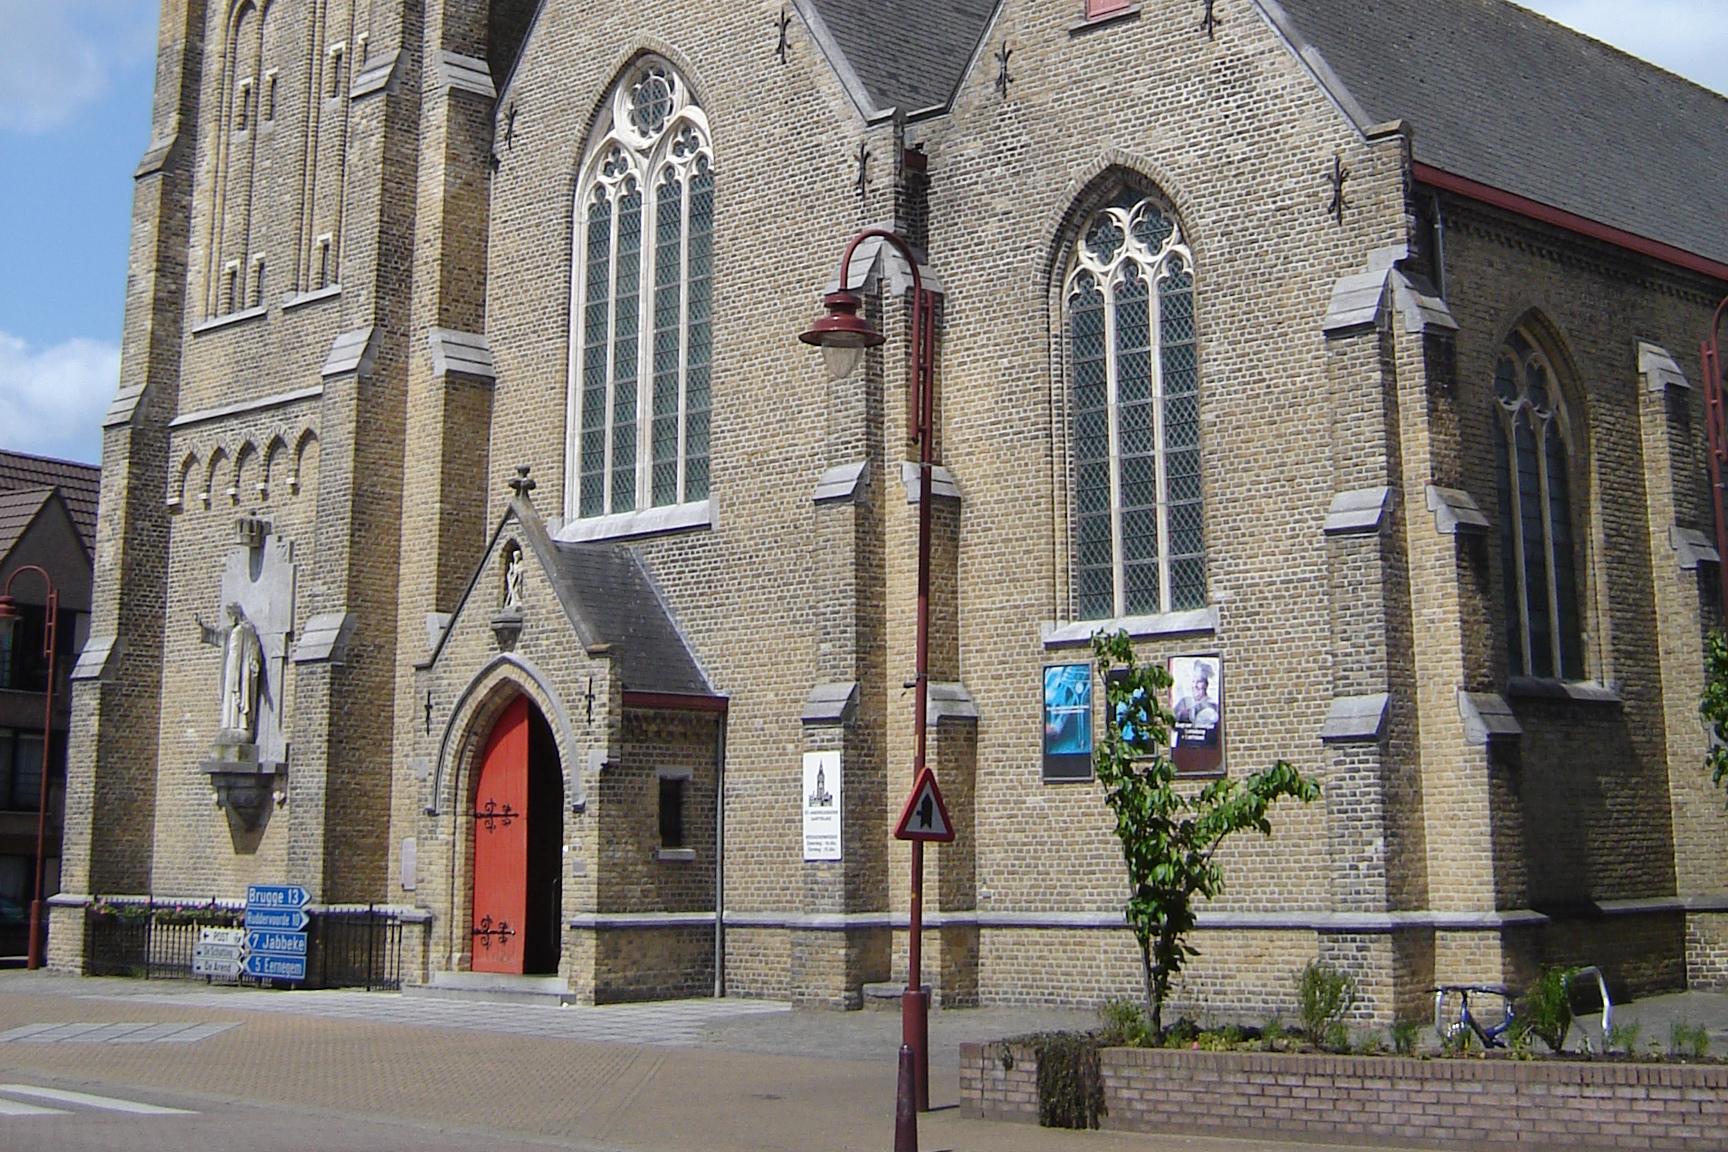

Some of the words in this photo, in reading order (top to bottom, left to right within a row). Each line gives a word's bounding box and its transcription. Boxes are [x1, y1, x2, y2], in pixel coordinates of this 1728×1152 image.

[249, 888, 284, 906] Brugge
[288, 889, 299, 904] 13
[292, 913, 300, 926] 10
[213, 931, 229, 942] POST
[253, 934, 259, 948] 7
[263, 934, 305, 952] Jabbeke
[255, 957, 261, 972] 5
[264, 957, 302, 977] Eernegem
